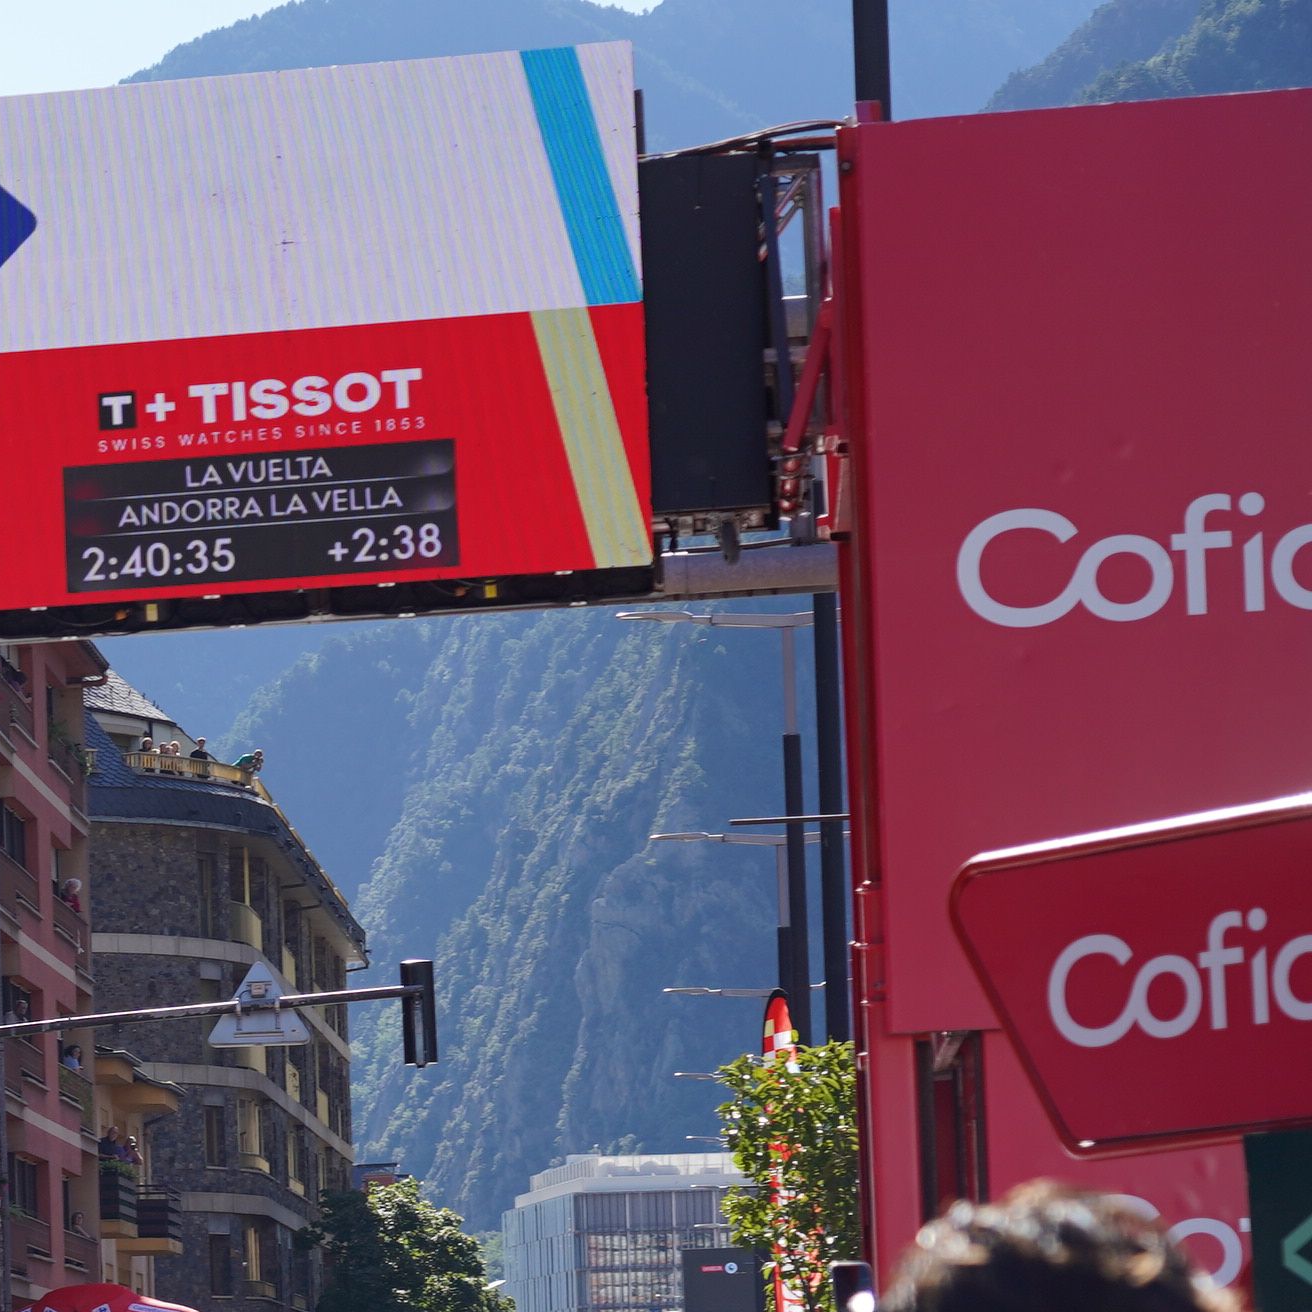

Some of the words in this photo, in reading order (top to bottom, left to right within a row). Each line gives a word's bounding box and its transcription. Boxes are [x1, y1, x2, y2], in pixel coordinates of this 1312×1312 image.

[188, 368, 422, 424] TISSOT
[98, 435, 166, 454] SWISS
[178, 426, 283, 449] WATCHES
[295, 419, 362, 439] SINCE
[374, 415, 427, 433] 1853
[185, 464, 222, 489] LA
[228, 456, 333, 484] VUELTA
[118, 496, 264, 529] ANDORRA
[270, 492, 308, 517] LA
[312, 485, 404, 514] VELLA
[82, 538, 235, 583] 2:40:35
[327, 523, 443, 564] +2:38
